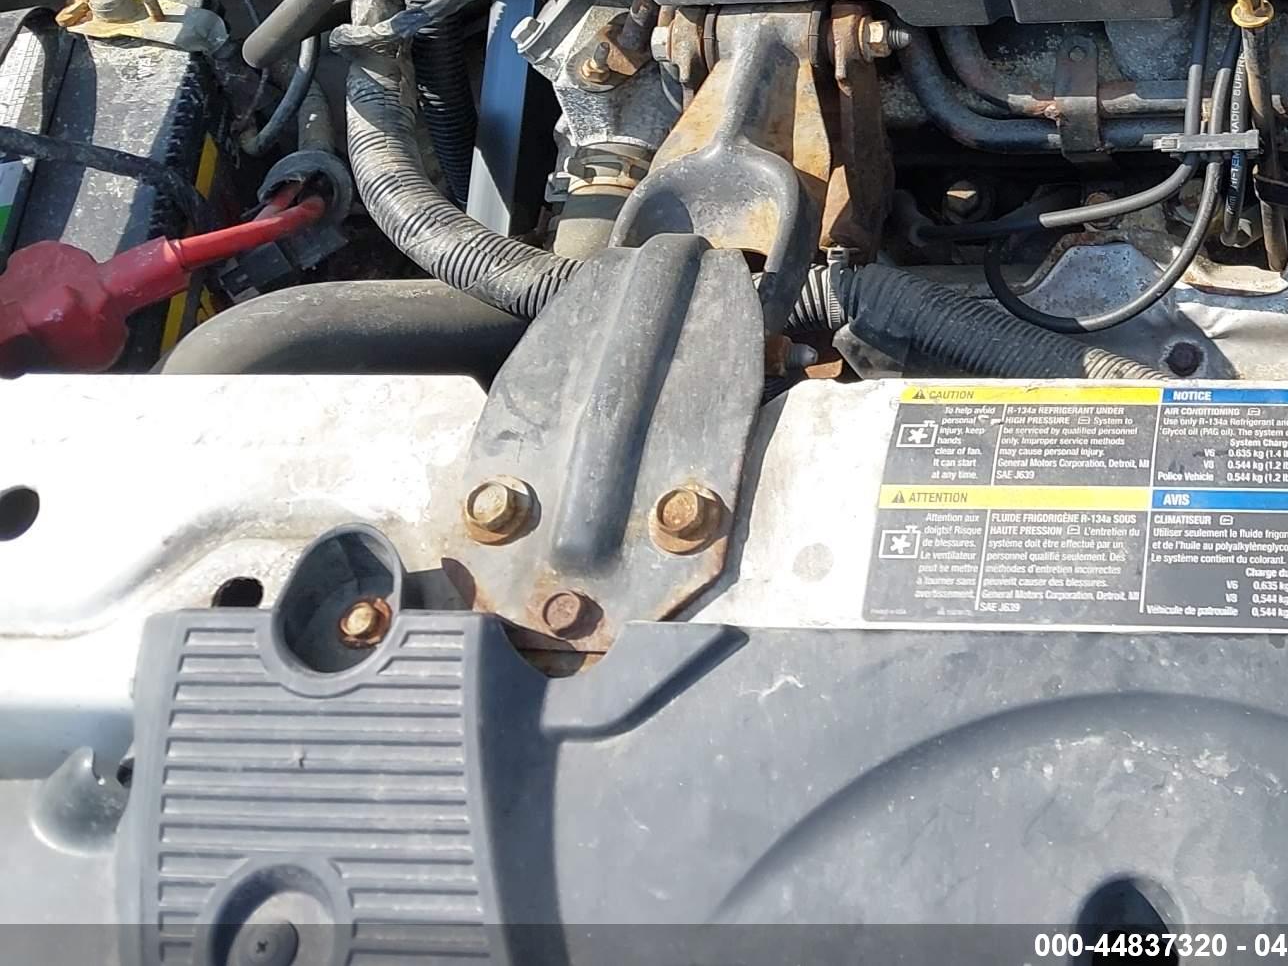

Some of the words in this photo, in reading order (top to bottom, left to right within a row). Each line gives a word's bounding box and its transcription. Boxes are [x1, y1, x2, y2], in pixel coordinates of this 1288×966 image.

[929, 391, 974, 399] CAUTION
[1173, 391, 1212, 401] NOTICE
[955, 406, 972, 415] help
[1038, 407, 1095, 415] REFRIGERANT
[1096, 407, 1125, 415] UNDER
[1164, 408, 1180, 416] AIR
[1182, 408, 1240, 416] CONDITIONING
[942, 417, 976, 425] personal
[1094, 417, 1123, 426] System
[1163, 418, 1178, 426] Use
[1180, 418, 1198, 427] only
[1230, 418, 1274, 428] Refrigerant
[966, 427, 985, 435] keep
[1062, 428, 1097, 436] qualified
[1098, 428, 1138, 436] personnel
[1162, 428, 1187, 437] Glycol
[1188, 428, 1199, 436] oil
[1200, 428, 1219, 437] (PAG
[1238, 428, 1253, 437] The
[1255, 430, 1284, 438] system
[1001, 438, 1020, 446] only.
[1022, 437, 1057, 446] Improper
[1230, 439, 1262, 448] System
[935, 447, 955, 455] clear
[967, 447, 982, 455] fan.
[1000, 448, 1017, 456] may
[1044, 448, 1079, 456] personal
[1080, 448, 1105, 457] injury.
[1204, 449, 1216, 457] V6
[1228, 450, 1251, 458] 0.635
[1253, 450, 1264, 460] kg
[1266, 449, 1282, 460] (1.4
[941, 459, 956, 467] can
[957, 458, 977, 467] start
[998, 458, 1028, 467] General
[1030, 458, 1057, 467] Motors
[1059, 458, 1106, 469] Corporation,
[1139, 460, 1150, 468] MI
[1228, 461, 1251, 470] 0.544
[1253, 461, 1264, 471] kg
[1265, 461, 1282, 471] (1.2
[941, 471, 957, 481] any
[996, 470, 1012, 479] SAE
[1014, 470, 1035, 479] J639
[1158, 472, 1182, 481] Police
[1184, 472, 1214, 481] Vehicle
[1227, 474, 1250, 482] 0.544
[1252, 474, 1264, 483] kg
[1265, 473, 1282, 483] (1.2
[908, 493, 968, 503] ATTENTION
[1163, 494, 1190, 506] AVIS
[926, 513, 963, 522] Attention
[965, 514, 980, 522] aux
[992, 513, 1021, 523] FLUIDE
[1023, 512, 1079, 523] FRIGORIGÈNE
[1081, 514, 1112, 524] R-134a
[1113, 515, 1136, 524] SOUS
[1154, 516, 1212, 525] CLIMATISEUR
[954, 526, 982, 536] Risque
[990, 526, 1019, 534] HAUTE
[1020, 526, 1062, 535] PRESSION
[1129, 528, 1140, 537] du
[1153, 528, 1182, 537] Utiliser
[1184, 528, 1228, 538] seulement
[1239, 529, 1263, 539] fluide
[922, 538, 933, 547] de
[1024, 539, 1040, 547] doit
[1042, 539, 1059, 548] être
[1061, 539, 1095, 548] effectué
[1096, 541, 1111, 550] par
[1163, 542, 1174, 551] de
[1175, 542, 1201, 551] l'huile
[986, 552, 1028, 561] personnel
[1109, 552, 1126, 562] Des
[1151, 554, 1162, 562] Le
[1200, 554, 1235, 564] contient
[1246, 568, 1277, 579] Charge
[1048, 578, 1064, 587] des
[1015, 591, 1043, 599] Motors
[980, 602, 998, 611] SAE
[999, 603, 1020, 612] J639
